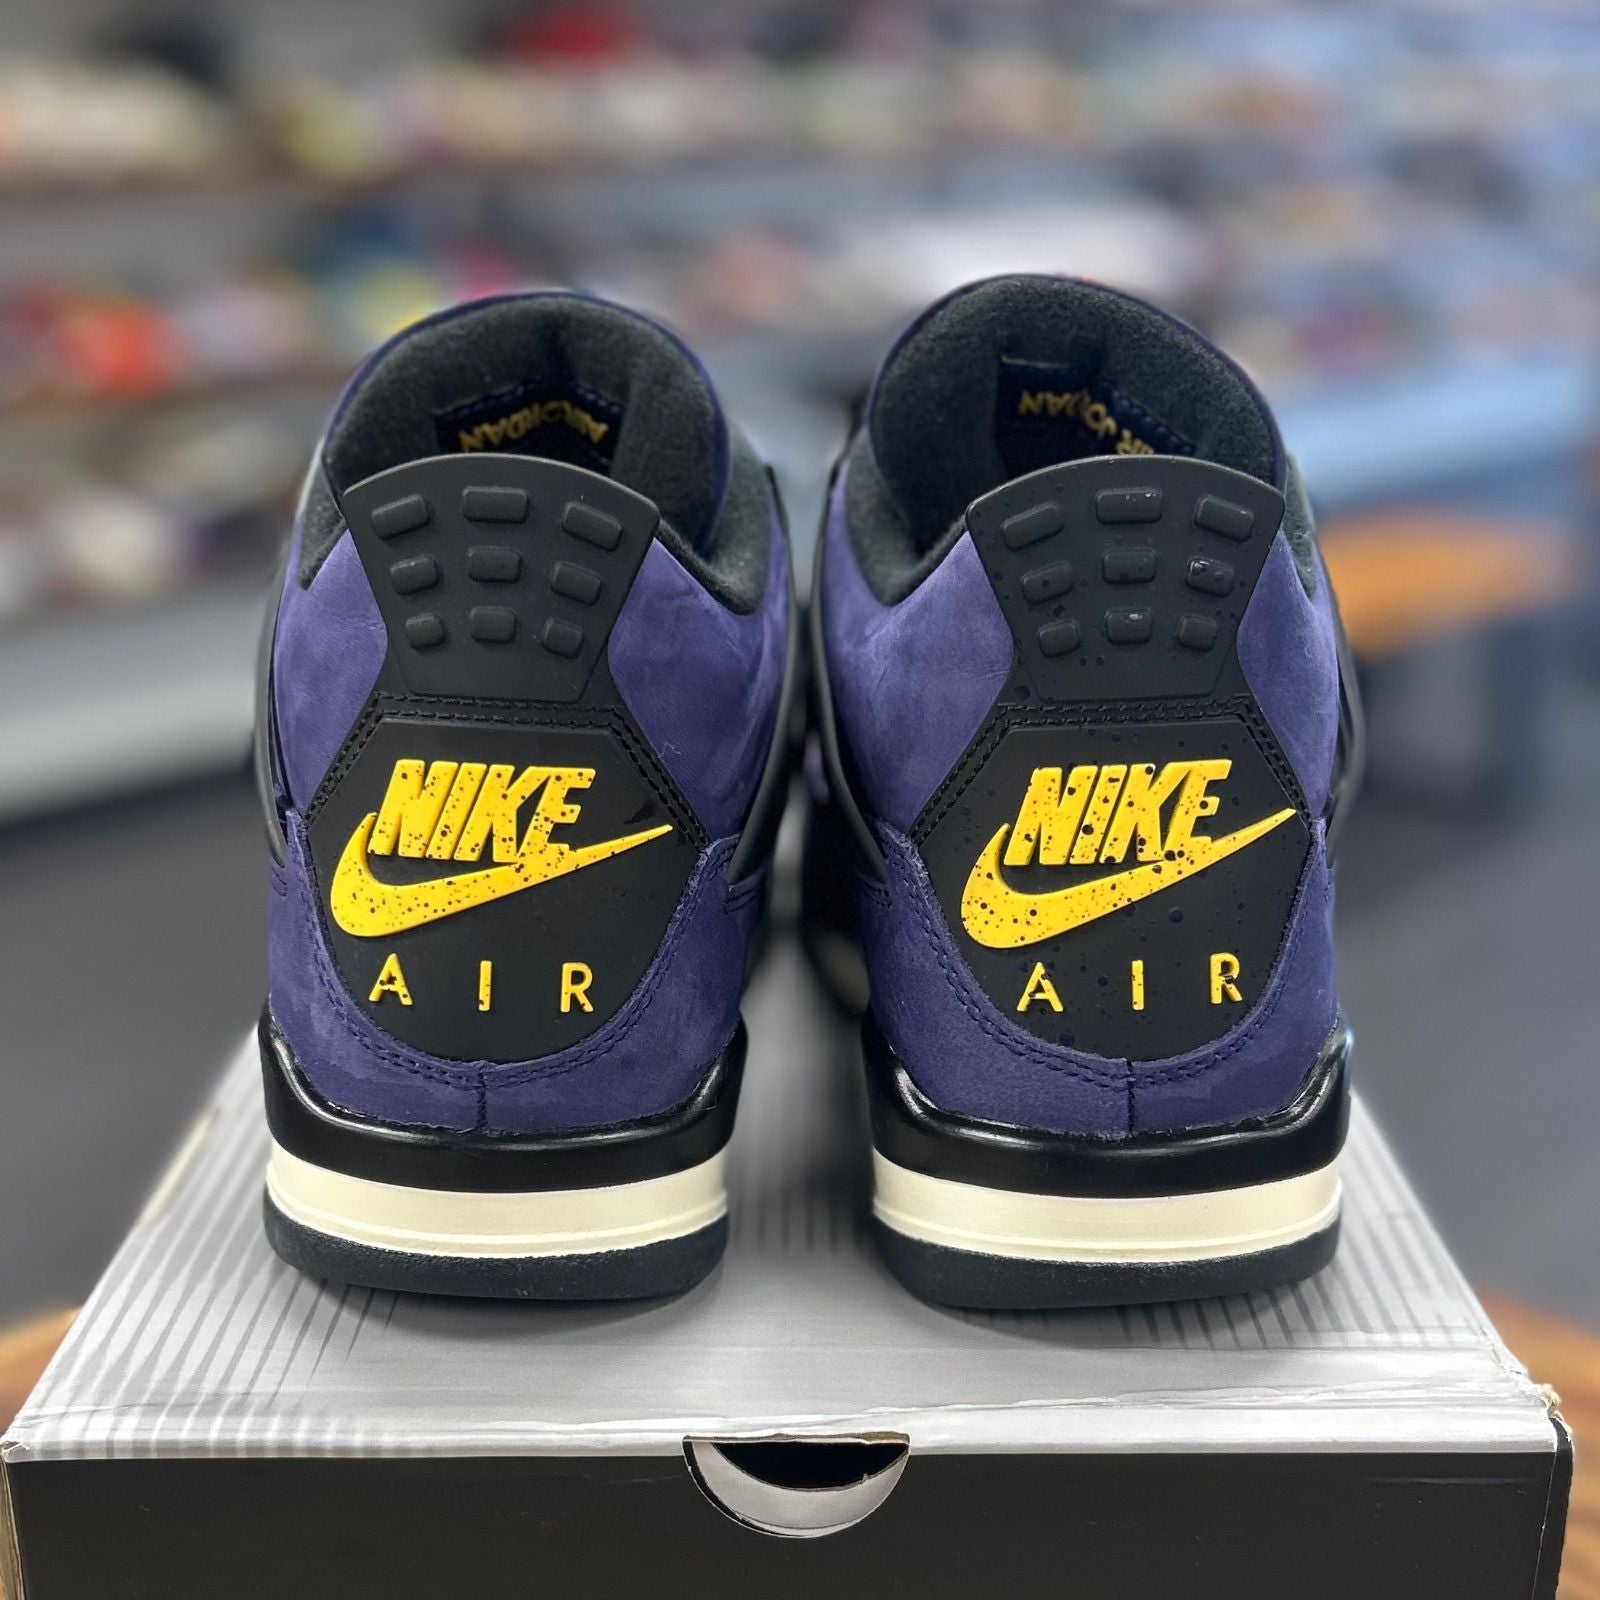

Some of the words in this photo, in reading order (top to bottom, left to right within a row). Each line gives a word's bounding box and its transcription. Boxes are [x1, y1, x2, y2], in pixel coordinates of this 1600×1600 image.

[367, 758, 597, 864] NIKE
[1003, 758, 1233, 866] NIKE
[368, 953, 593, 1012] AIR
[1016, 952, 1243, 1012] AIR
